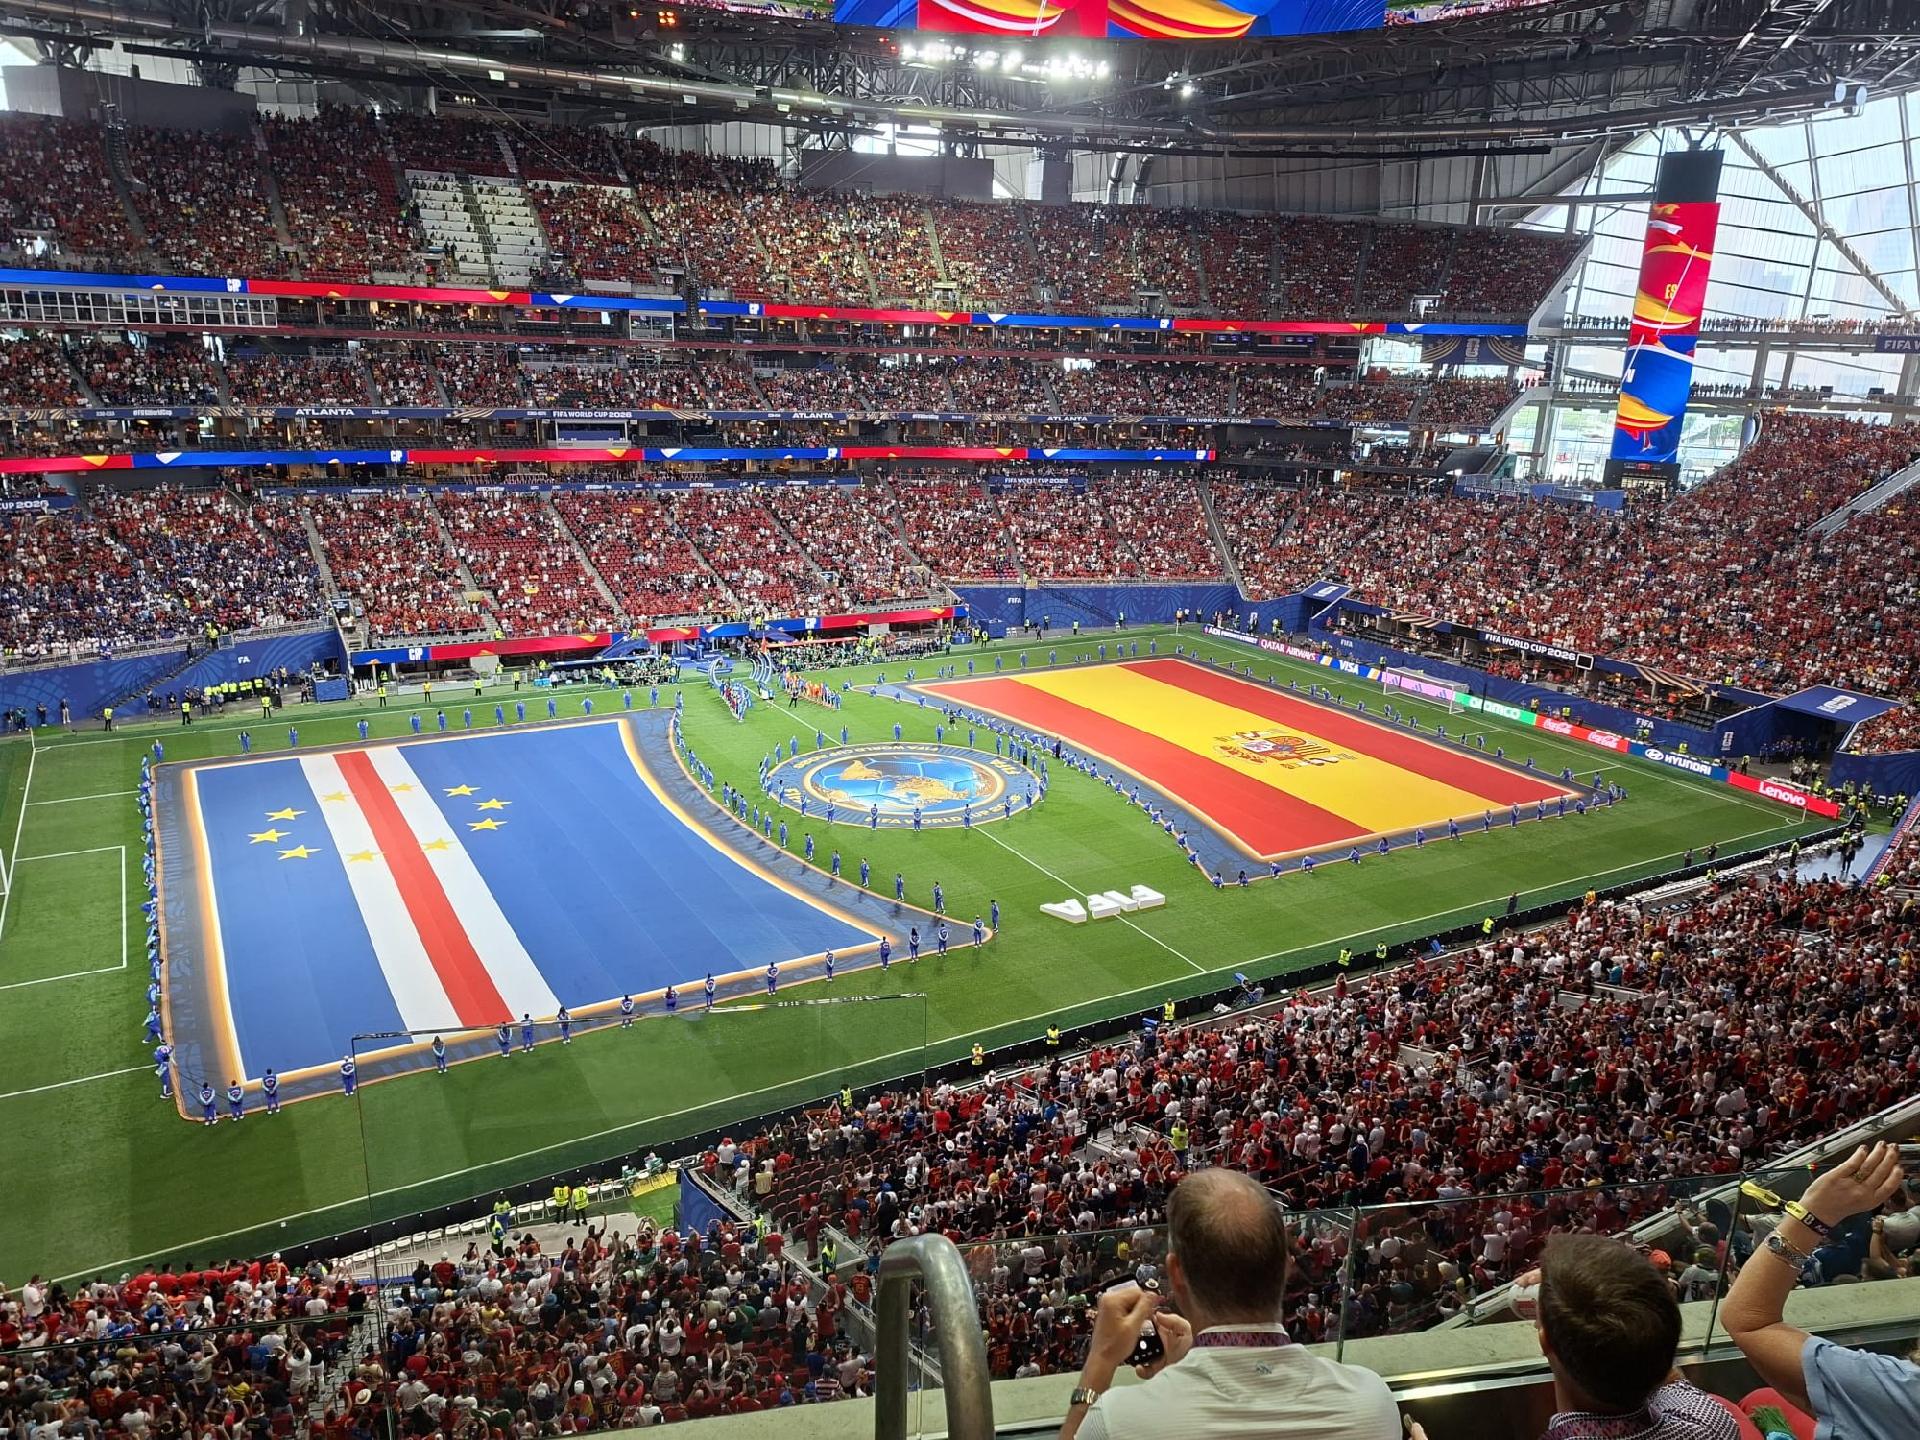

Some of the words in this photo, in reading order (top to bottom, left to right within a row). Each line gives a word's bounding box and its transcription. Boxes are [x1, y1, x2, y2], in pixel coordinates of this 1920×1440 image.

[1884, 340, 1911, 350] FIFA
[1260, 639, 1285, 652] QATAR
[1285, 645, 1316, 661] AIRWAYS
[1340, 639, 1353, 648] FIFA
[1485, 633, 1501, 643] FIFA
[1501, 637, 1530, 650] WORLD
[1530, 644, 1547, 654] CUP
[1547, 648, 1576, 661] 2026
[1339, 659, 1359, 675] VISA
[1636, 717, 1654, 729] FIFA
[1664, 754, 1712, 776] HYUNDAI
[1759, 781, 1806, 806] Lenovo
[1040, 884, 1166, 924] FIFA
